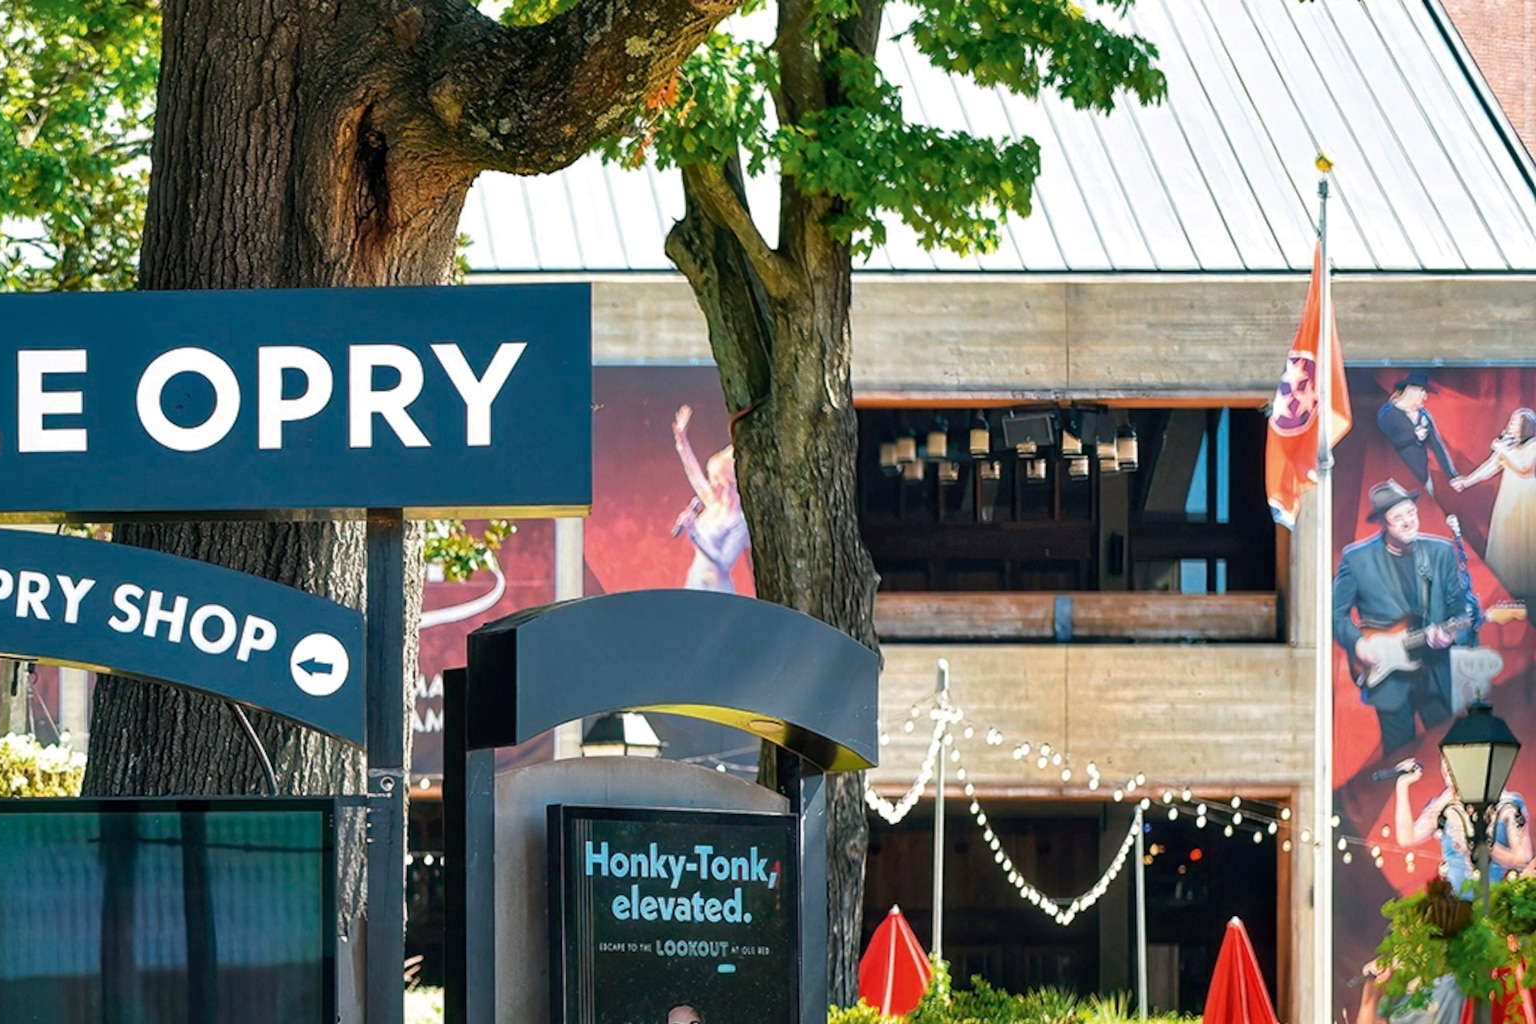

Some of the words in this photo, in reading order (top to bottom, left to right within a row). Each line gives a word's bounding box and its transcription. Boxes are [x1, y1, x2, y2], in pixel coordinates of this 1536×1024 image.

[137, 343, 527, 451] OPRY
[109, 585, 276, 661] SHOP
[585, 840, 778, 890] Honky-Tonk,
[611, 884, 753, 924] elevated.
[598, 942, 625, 952] ESCAPE
[627, 942, 638, 952] TO
[655, 939, 729, 958] LOOKOUT
